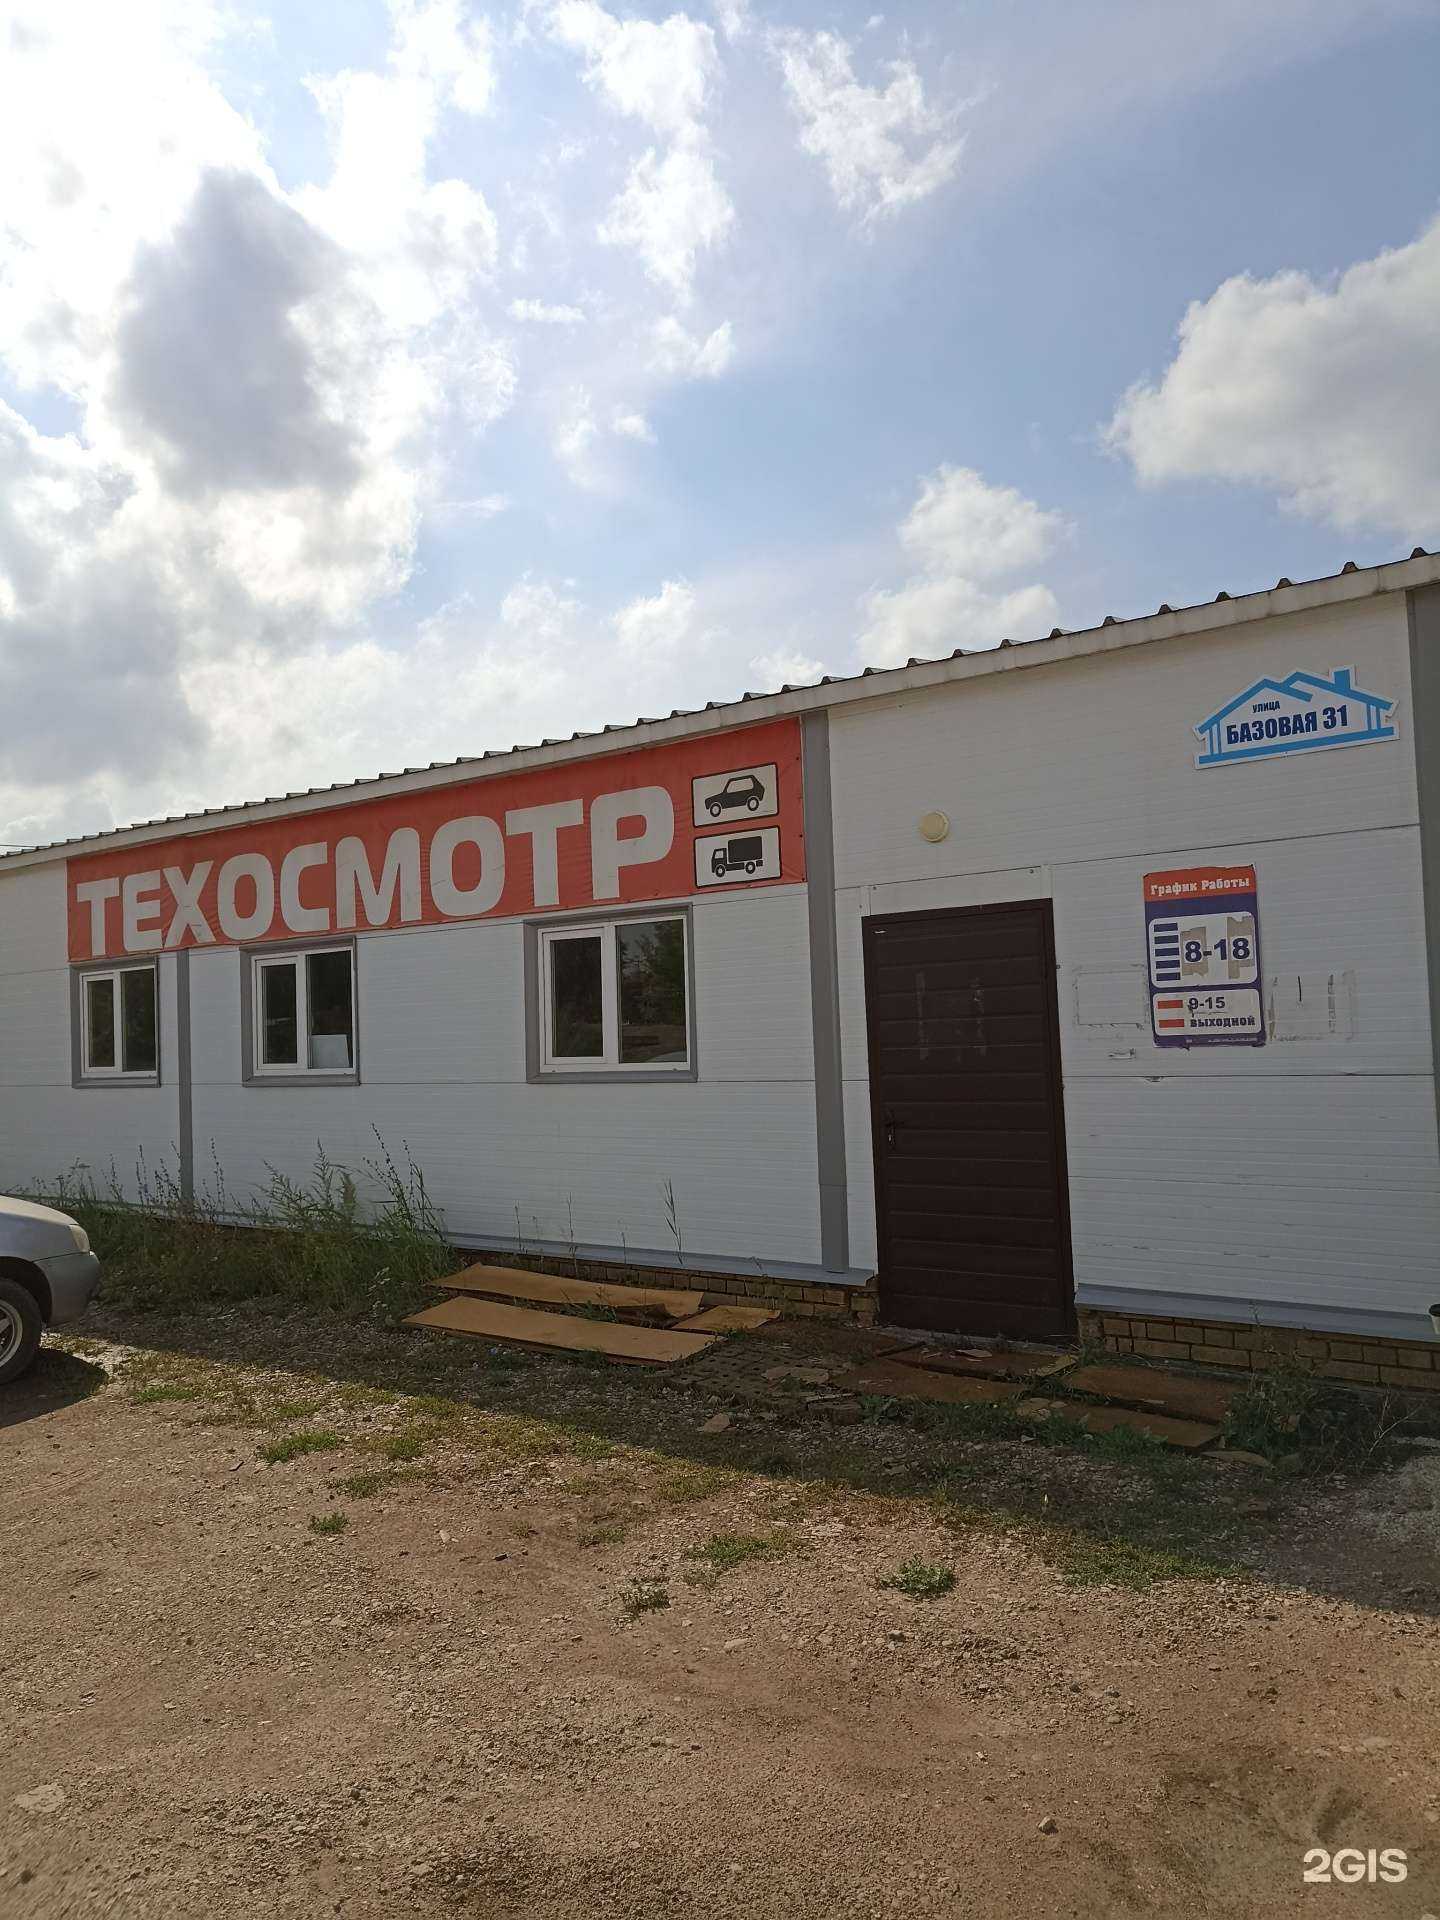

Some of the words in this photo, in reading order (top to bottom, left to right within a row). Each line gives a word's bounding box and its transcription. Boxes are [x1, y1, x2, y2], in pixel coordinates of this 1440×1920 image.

[1252, 700, 1281, 714] УЛИЦА
[1226, 712, 1318, 745] БАЗОВАЯ
[1322, 704, 1348, 727] 31
[75, 785, 675, 957] ТЕХОСМОТР
[1150, 881, 1198, 897] График
[1201, 877, 1250, 891] Работы
[1184, 937, 1251, 963] 8-18
[1188, 996, 1226, 1010] 9-15
